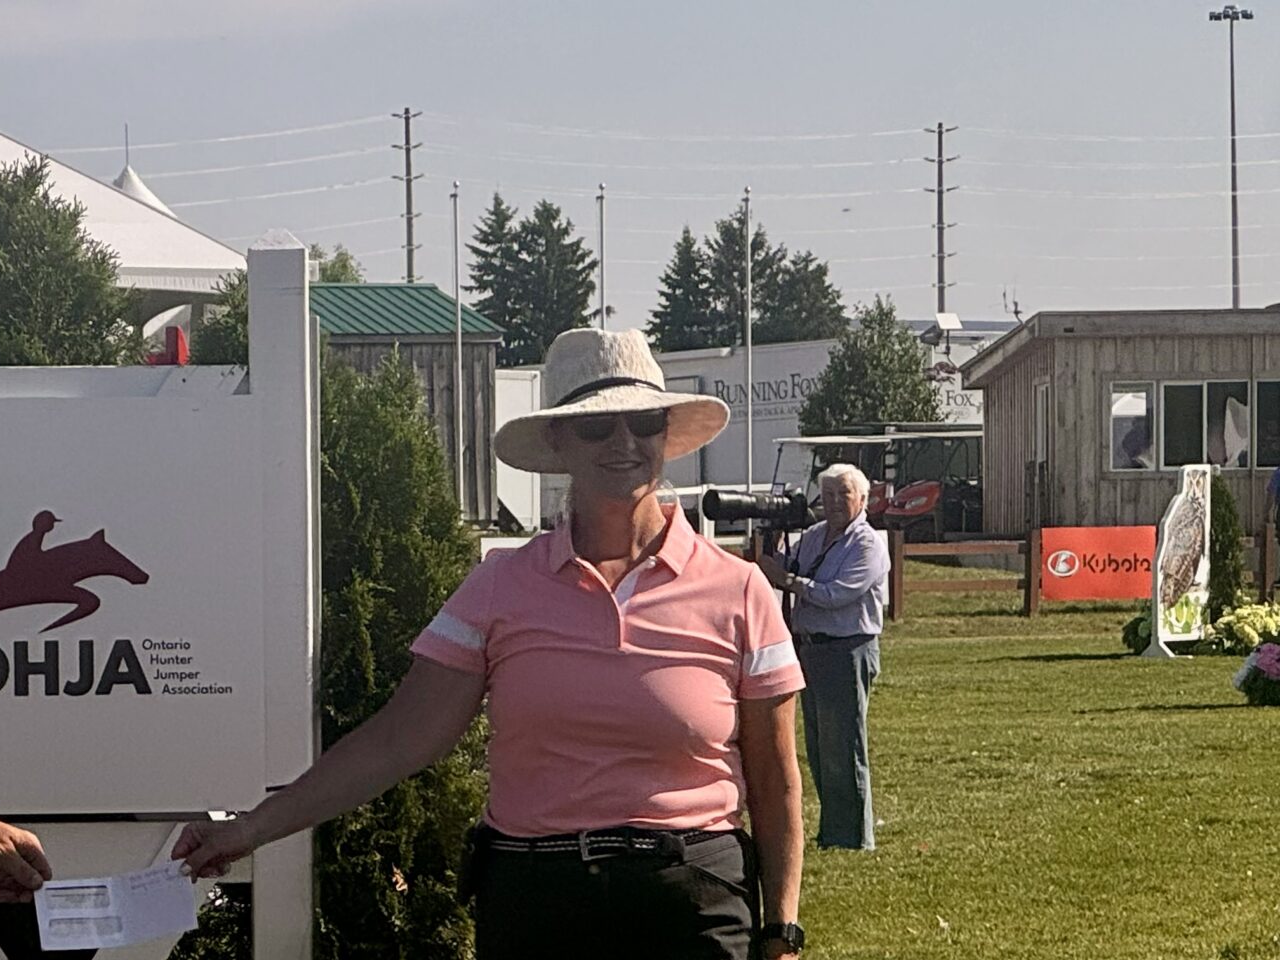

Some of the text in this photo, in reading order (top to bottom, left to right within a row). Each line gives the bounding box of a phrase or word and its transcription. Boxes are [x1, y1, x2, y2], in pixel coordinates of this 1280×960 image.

[714, 379, 788, 404] RUNNING
[1082, 552, 1152, 573] Kubota
[142, 638, 191, 650] Ontario
[150, 654, 193, 665] Hunter
[153, 669, 200, 682] Jumper
[162, 683, 233, 695] Association
